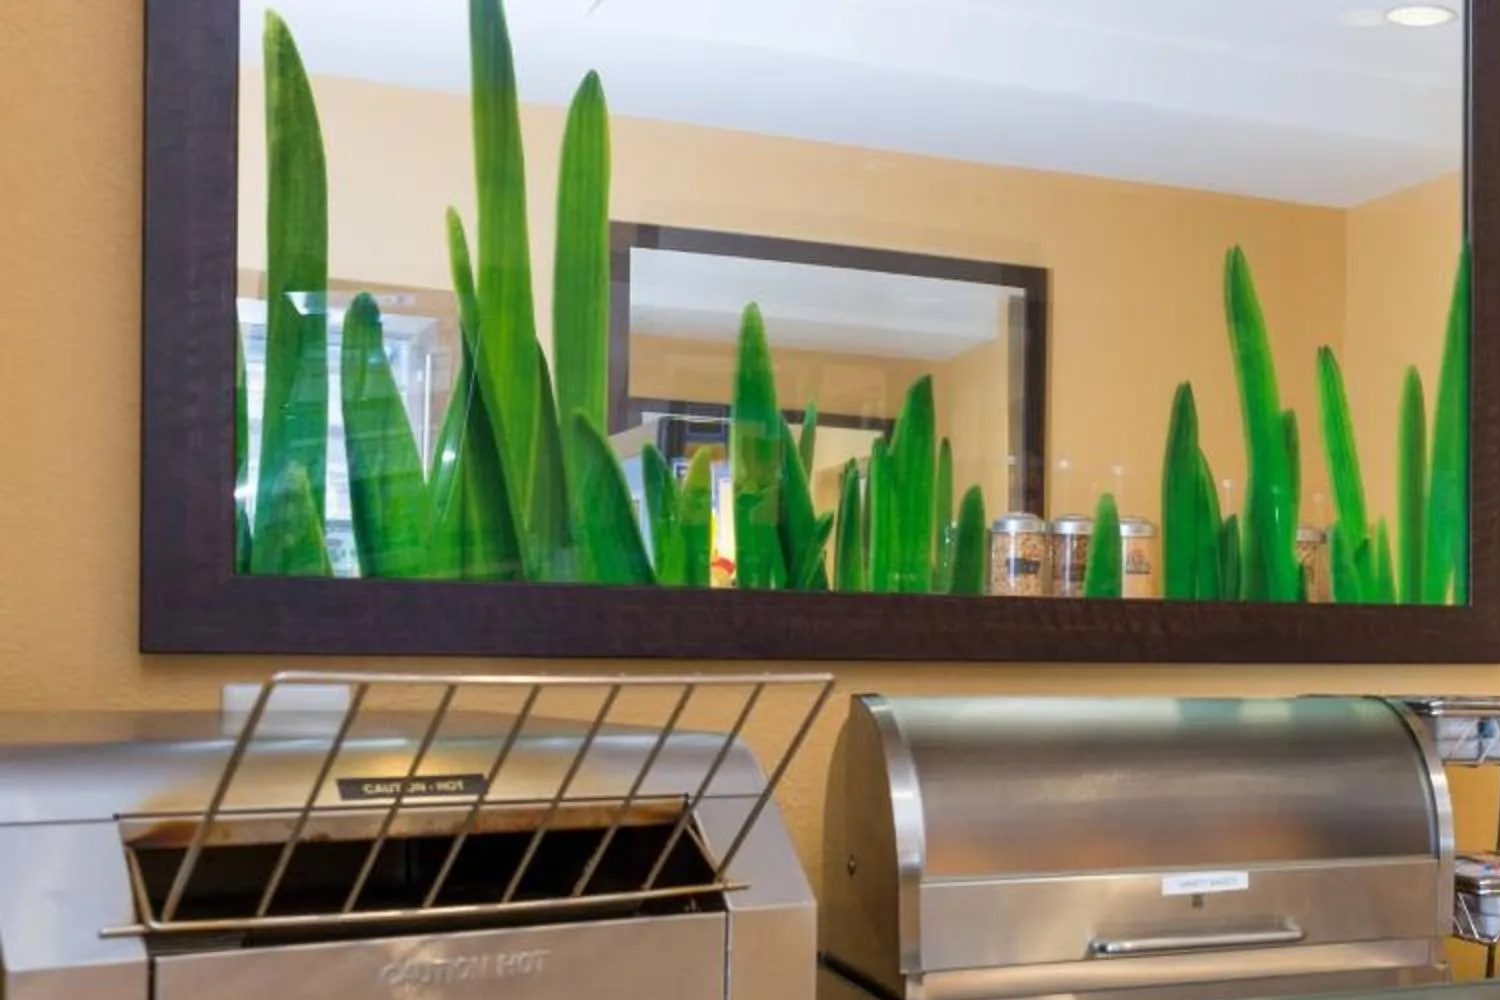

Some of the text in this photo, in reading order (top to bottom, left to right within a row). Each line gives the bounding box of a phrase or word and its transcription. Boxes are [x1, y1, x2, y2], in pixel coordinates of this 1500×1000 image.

[362, 782, 426, 795] CAUTON
[379, 949, 552, 985] CAUTION HOT
